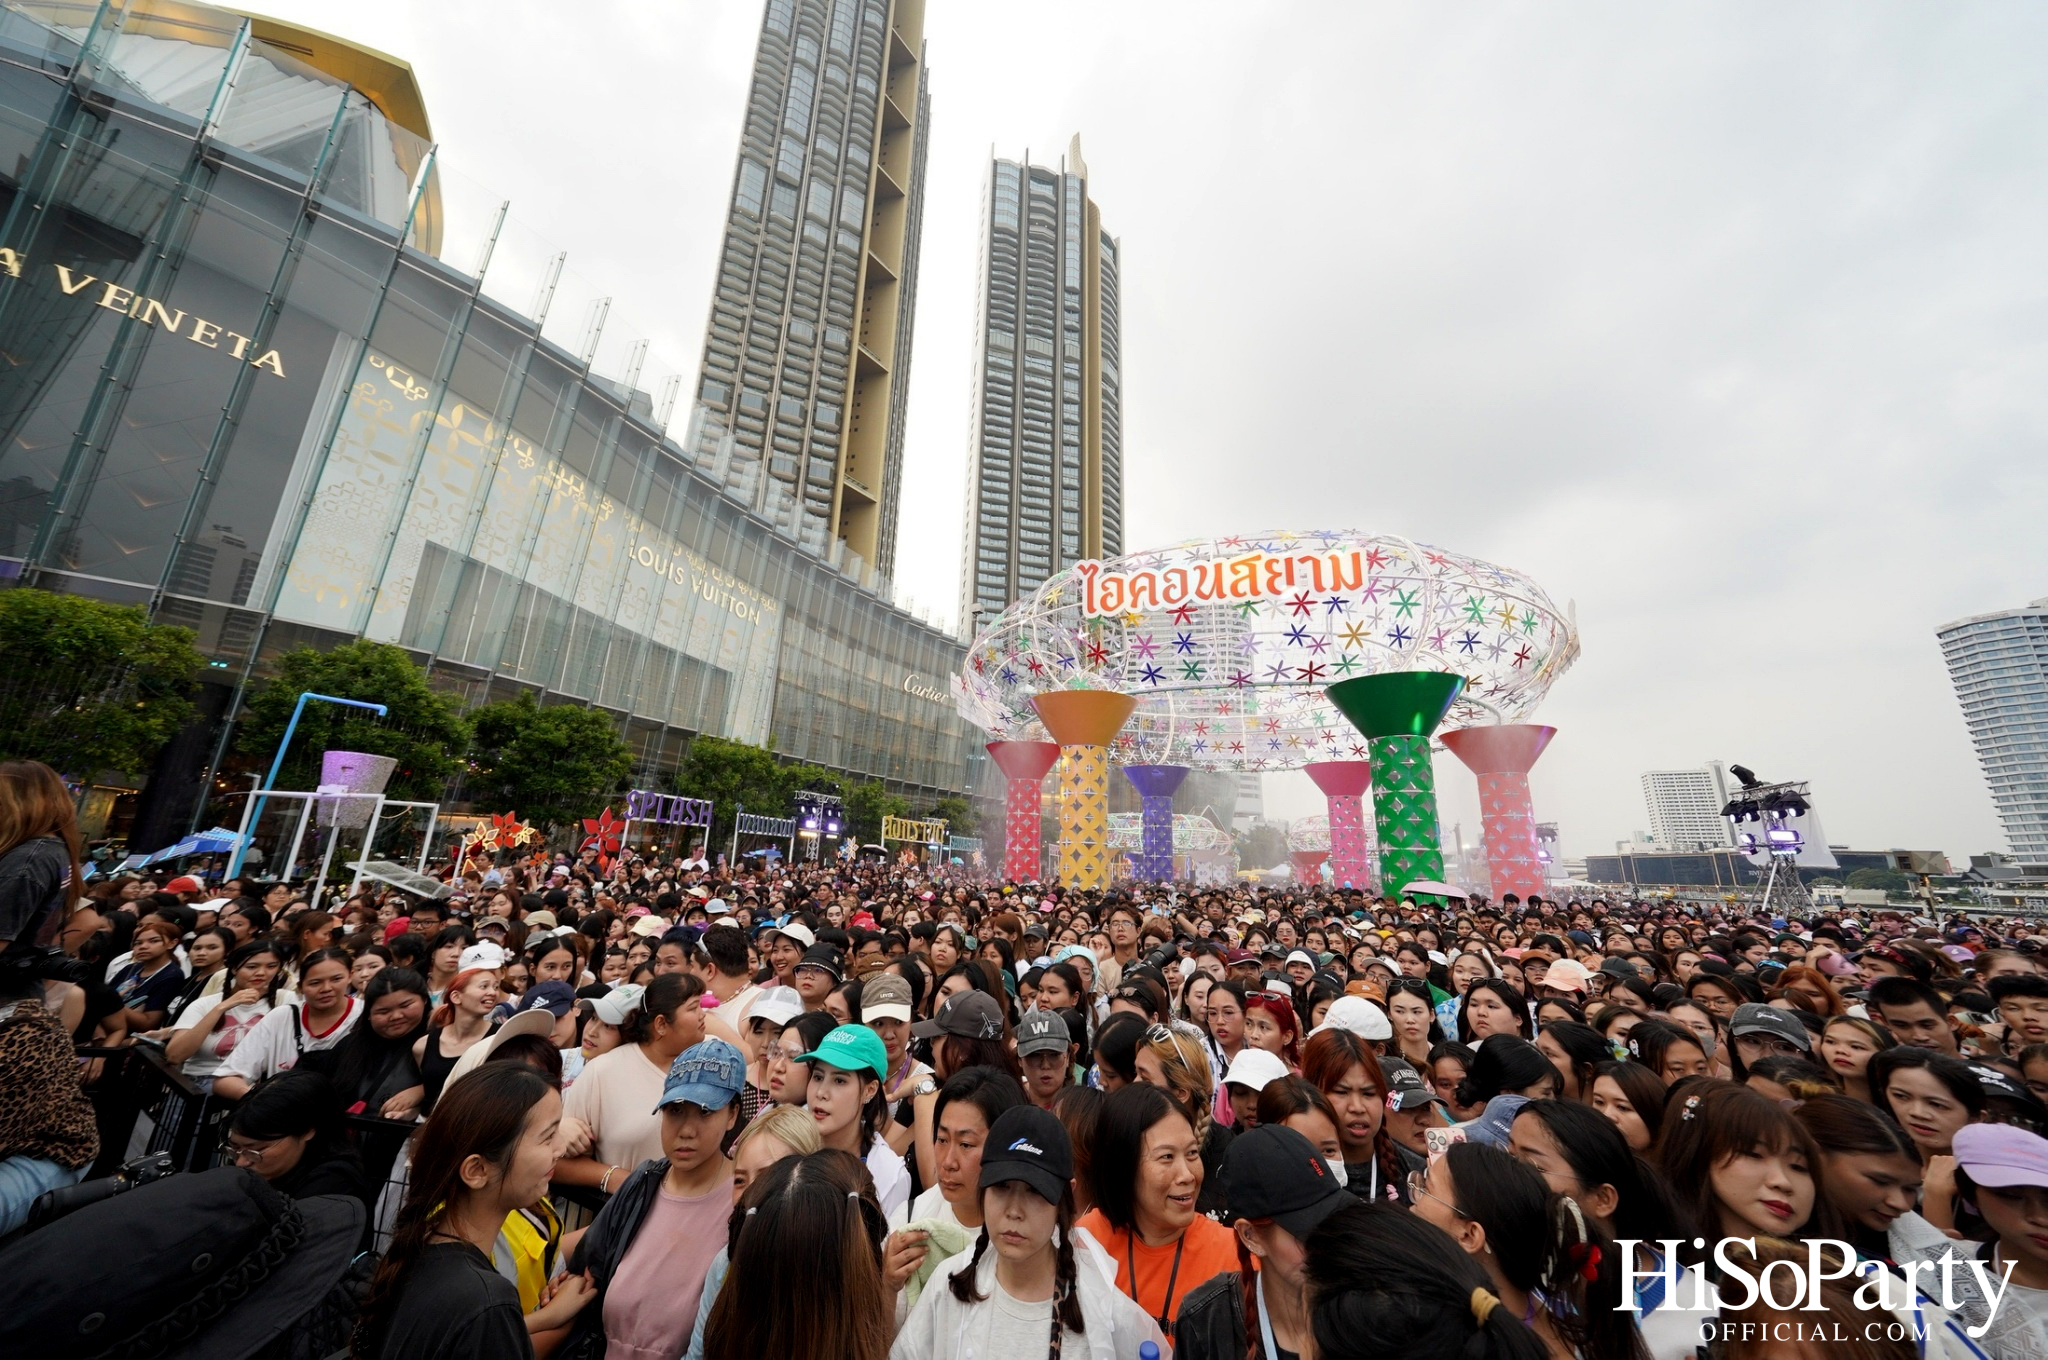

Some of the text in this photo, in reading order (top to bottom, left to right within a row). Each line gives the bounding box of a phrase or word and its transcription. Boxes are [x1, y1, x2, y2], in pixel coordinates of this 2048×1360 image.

[54, 263, 287, 379] VENETA
[629, 538, 760, 626] LOUIS VUITTON
[1077, 551, 1364, 614] ไอคอนสยาม
[903, 673, 949, 703] Cartier
[624, 790, 714, 828] SPLASH
[1030, 1020, 1049, 1035] W
